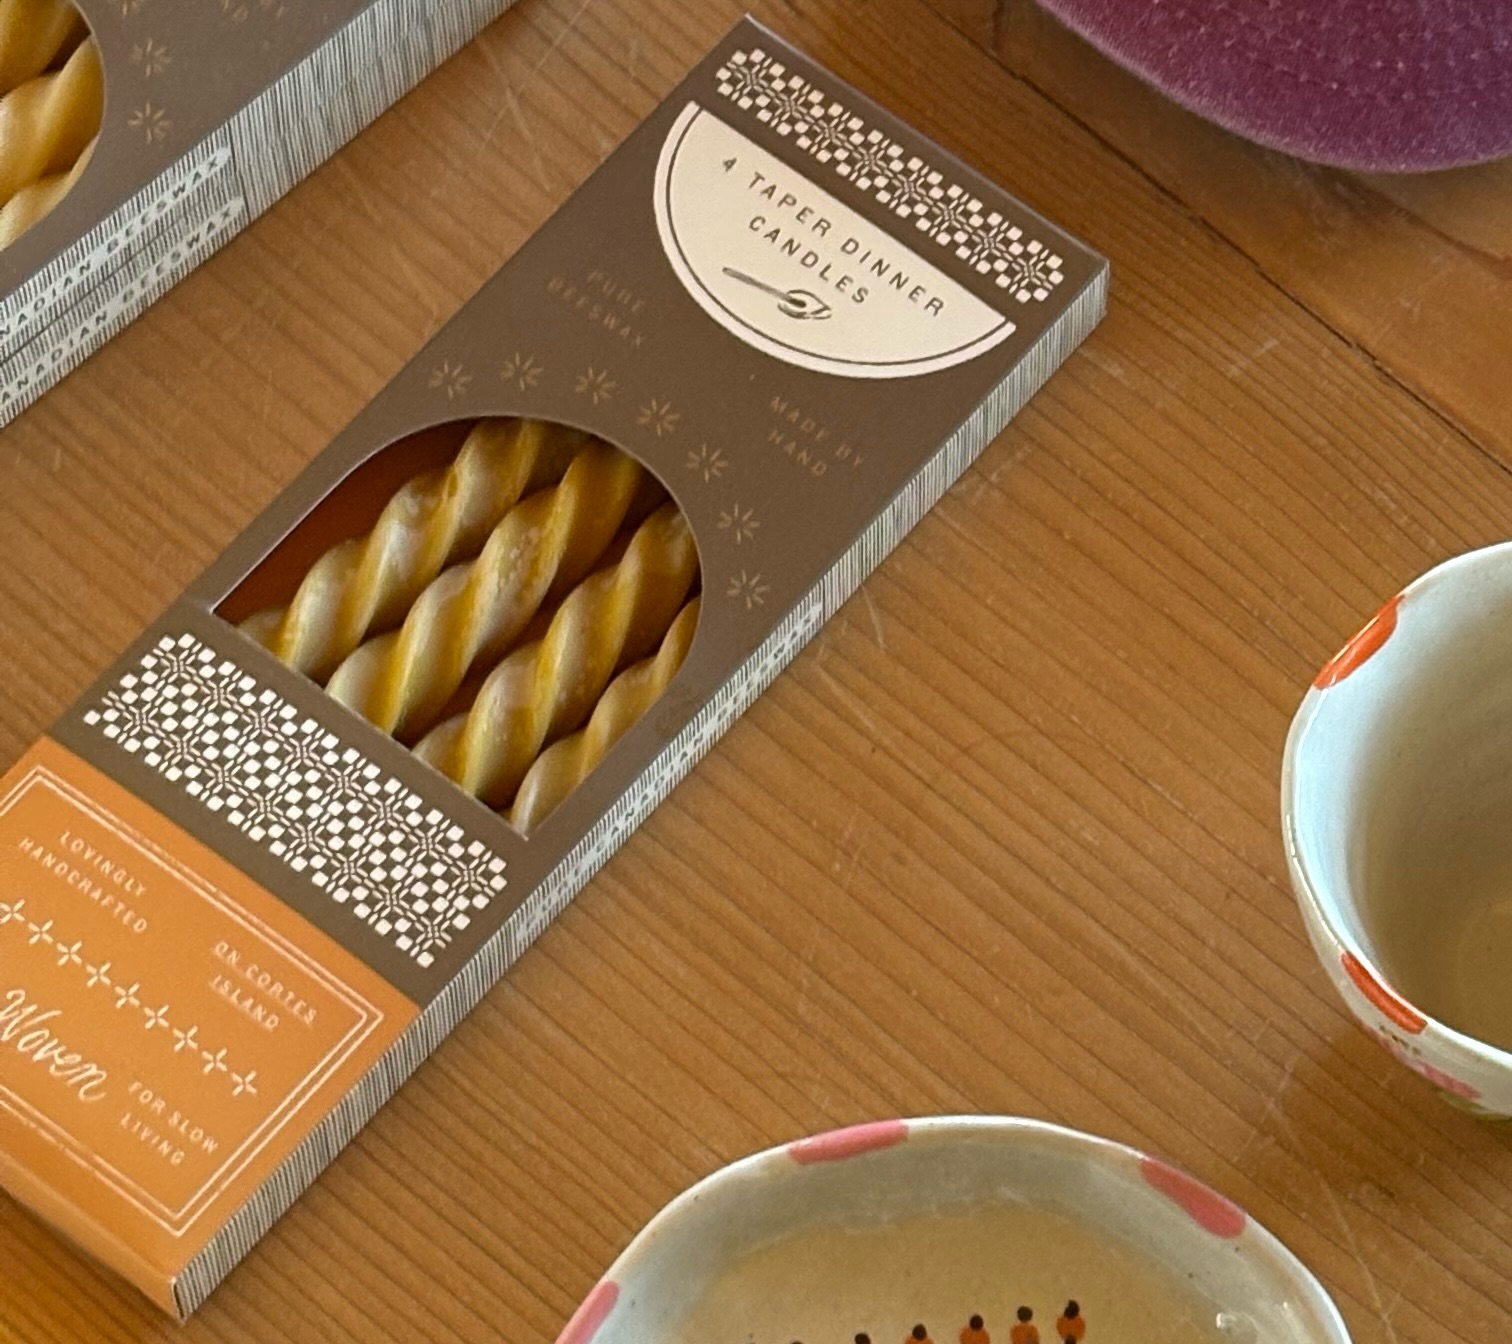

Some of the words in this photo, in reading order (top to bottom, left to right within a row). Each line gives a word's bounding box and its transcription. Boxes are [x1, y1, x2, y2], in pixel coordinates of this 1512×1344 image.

[721, 157, 738, 173] 4
[748, 171, 833, 239] TAPER
[840, 237, 946, 318] DINNER
[748, 215, 870, 305] CANDLES
[18, 837, 148, 934] HANDCRAFTED
[59, 829, 147, 897] LOVINGLY
[210, 974, 280, 1032] ISLAND
[213, 940, 241, 967] ON
[245, 963, 318, 1025] CORTES
[120, 1112, 186, 1168] LIVING
[127, 1080, 167, 1116] FOR
[167, 1109, 220, 1157] SLOW
